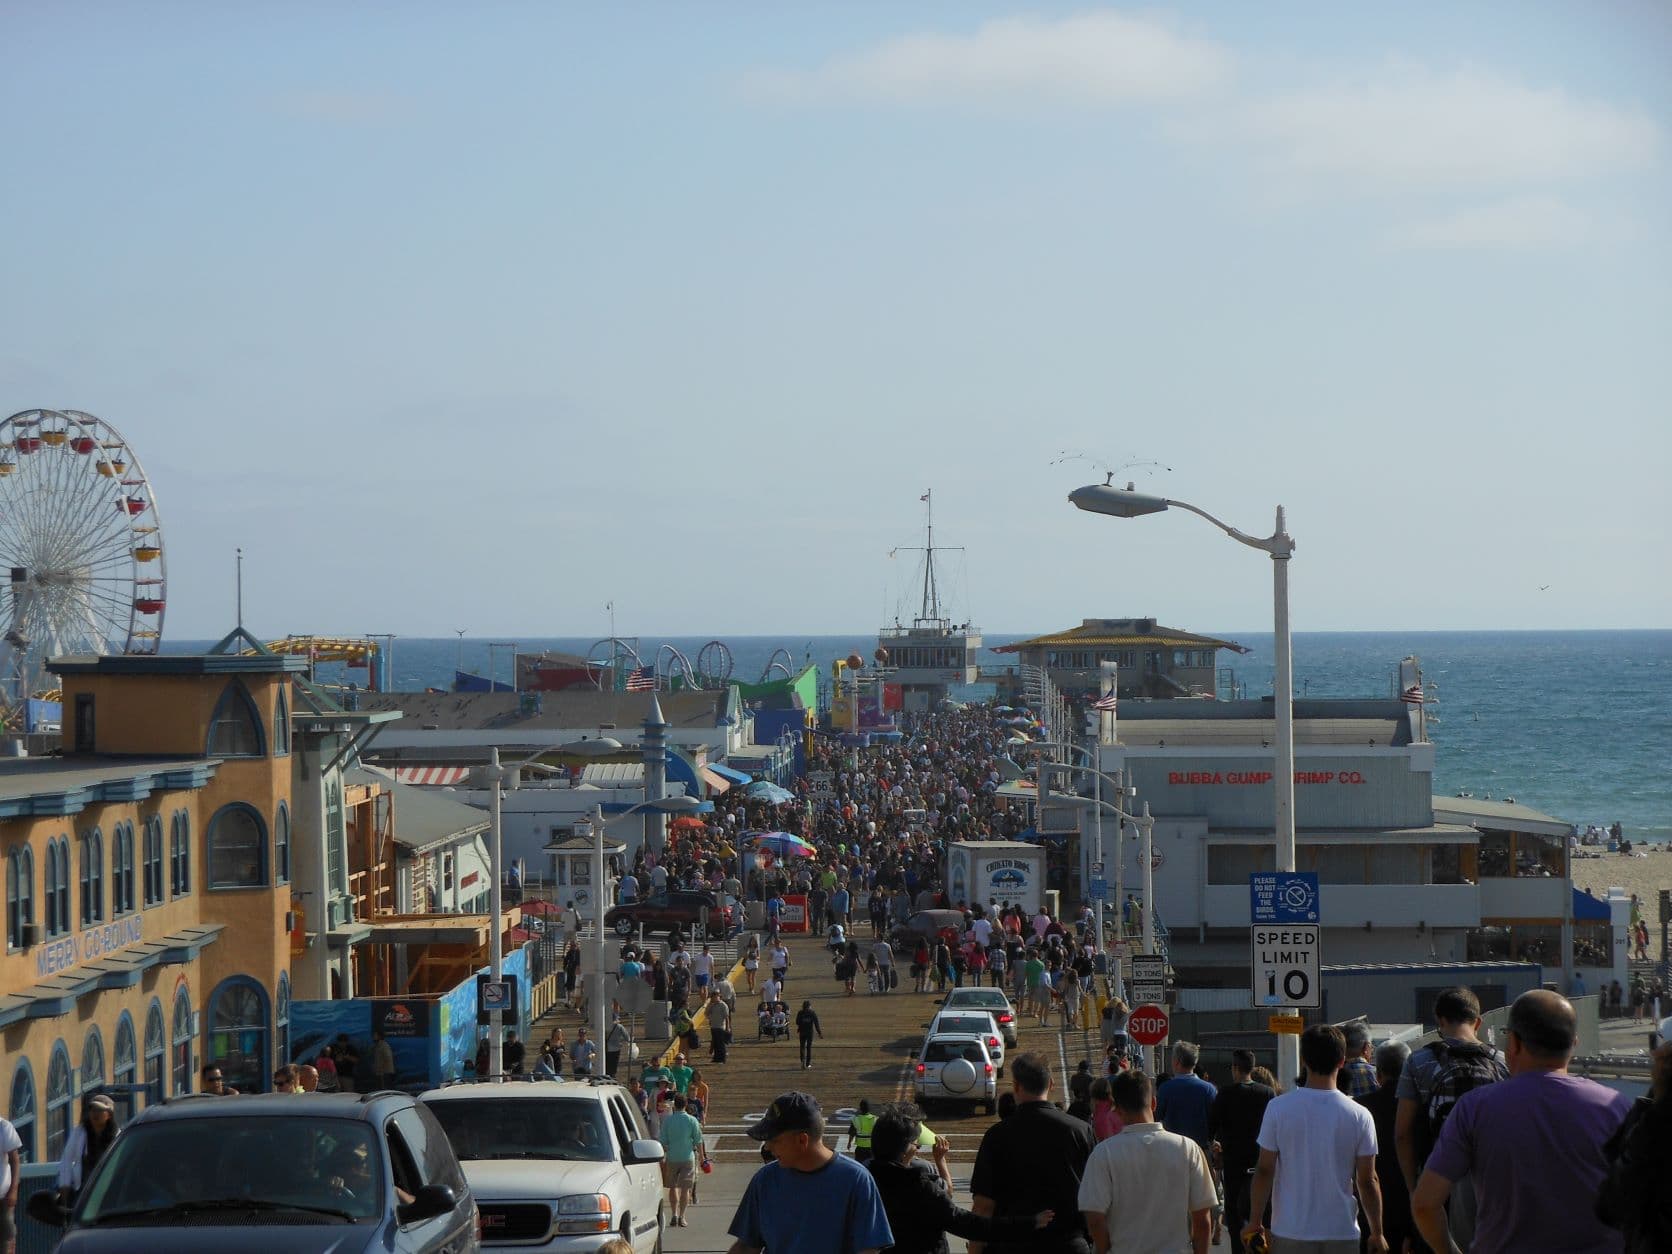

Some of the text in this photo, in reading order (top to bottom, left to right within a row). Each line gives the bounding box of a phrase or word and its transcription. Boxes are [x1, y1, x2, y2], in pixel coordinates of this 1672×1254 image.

[1169, 771, 1367, 784] BUBBA GUMP RIMP CO.
[1254, 884, 1264, 892] DO
[1264, 884, 1276, 892] NOT
[1258, 891, 1273, 899] FEED
[1256, 932, 1316, 945] SPEED
[36, 937, 81, 977] MERRY
[1262, 951, 1310, 964] LIMIT
[1264, 970, 1309, 1000] 10
[1131, 1018, 1167, 1033] STOP
